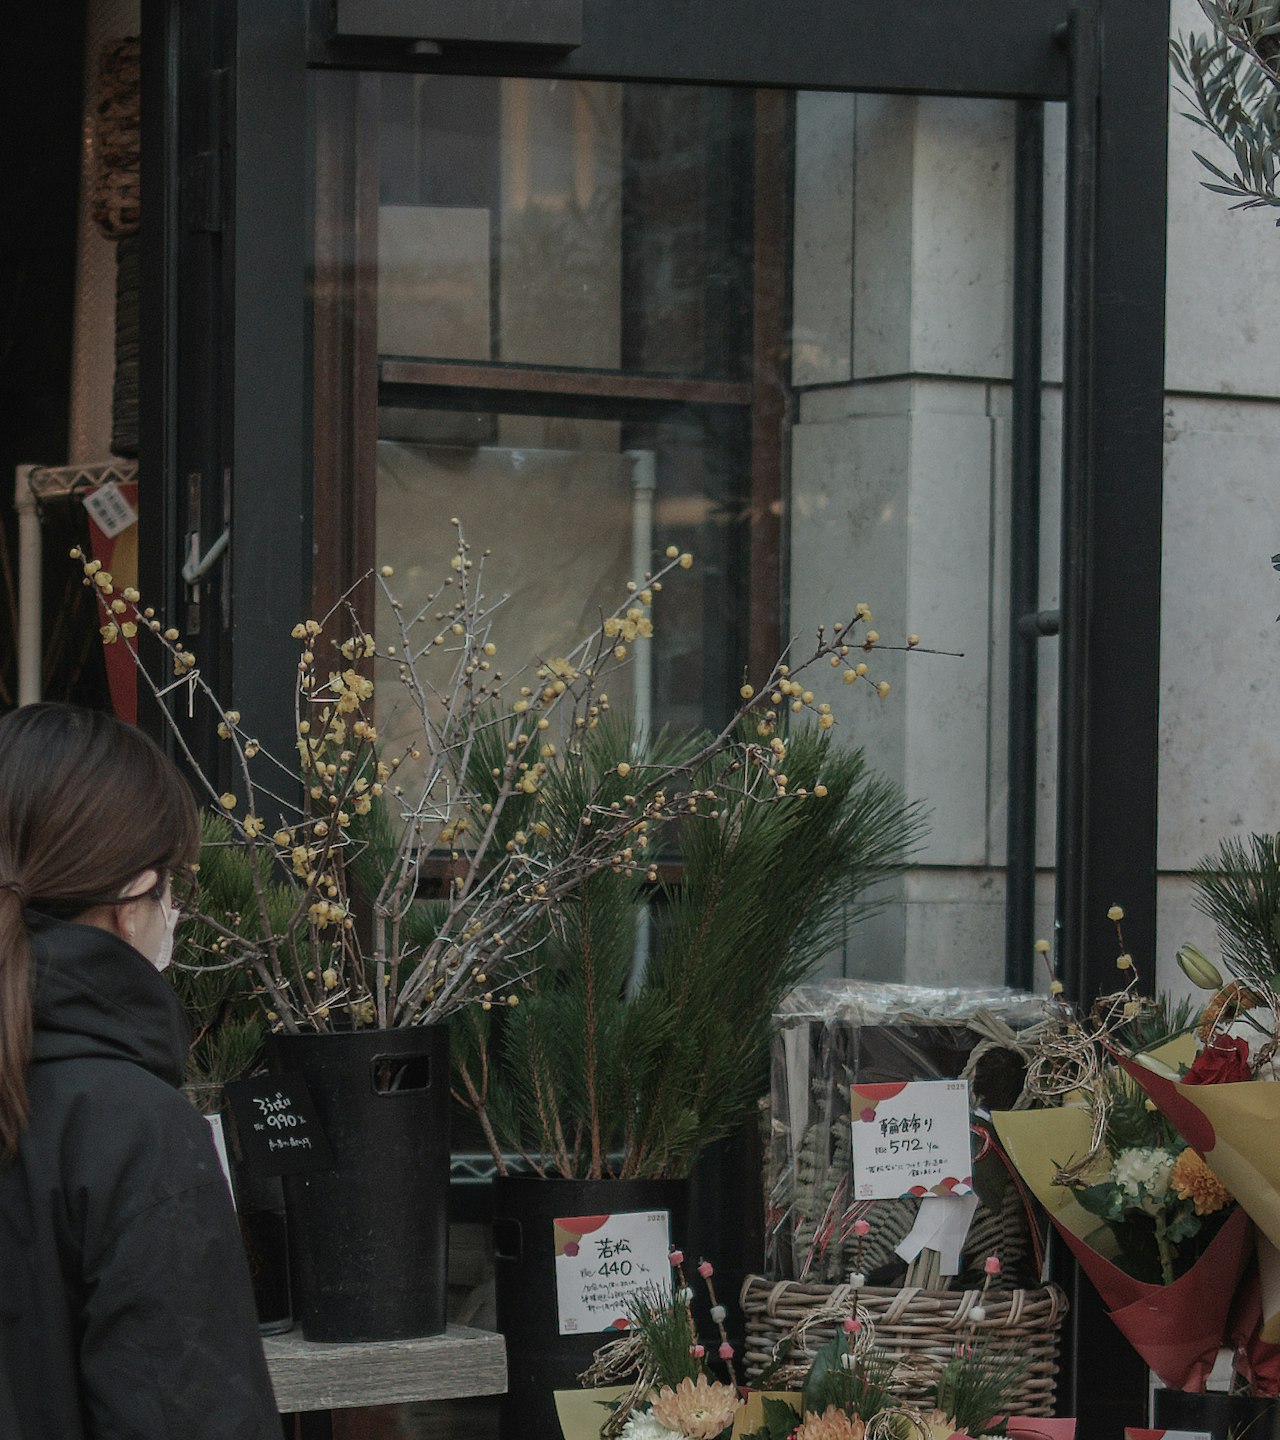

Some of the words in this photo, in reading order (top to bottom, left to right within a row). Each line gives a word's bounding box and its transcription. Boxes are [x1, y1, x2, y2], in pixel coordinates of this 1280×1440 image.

[946, 1083, 966, 1091] 2025
[266, 1113, 297, 1130] 990
[879, 1113, 933, 1138] 輪飾り
[889, 1138, 923, 1155] 572
[594, 1238, 632, 1259] 若松
[598, 1260, 632, 1278] 440
